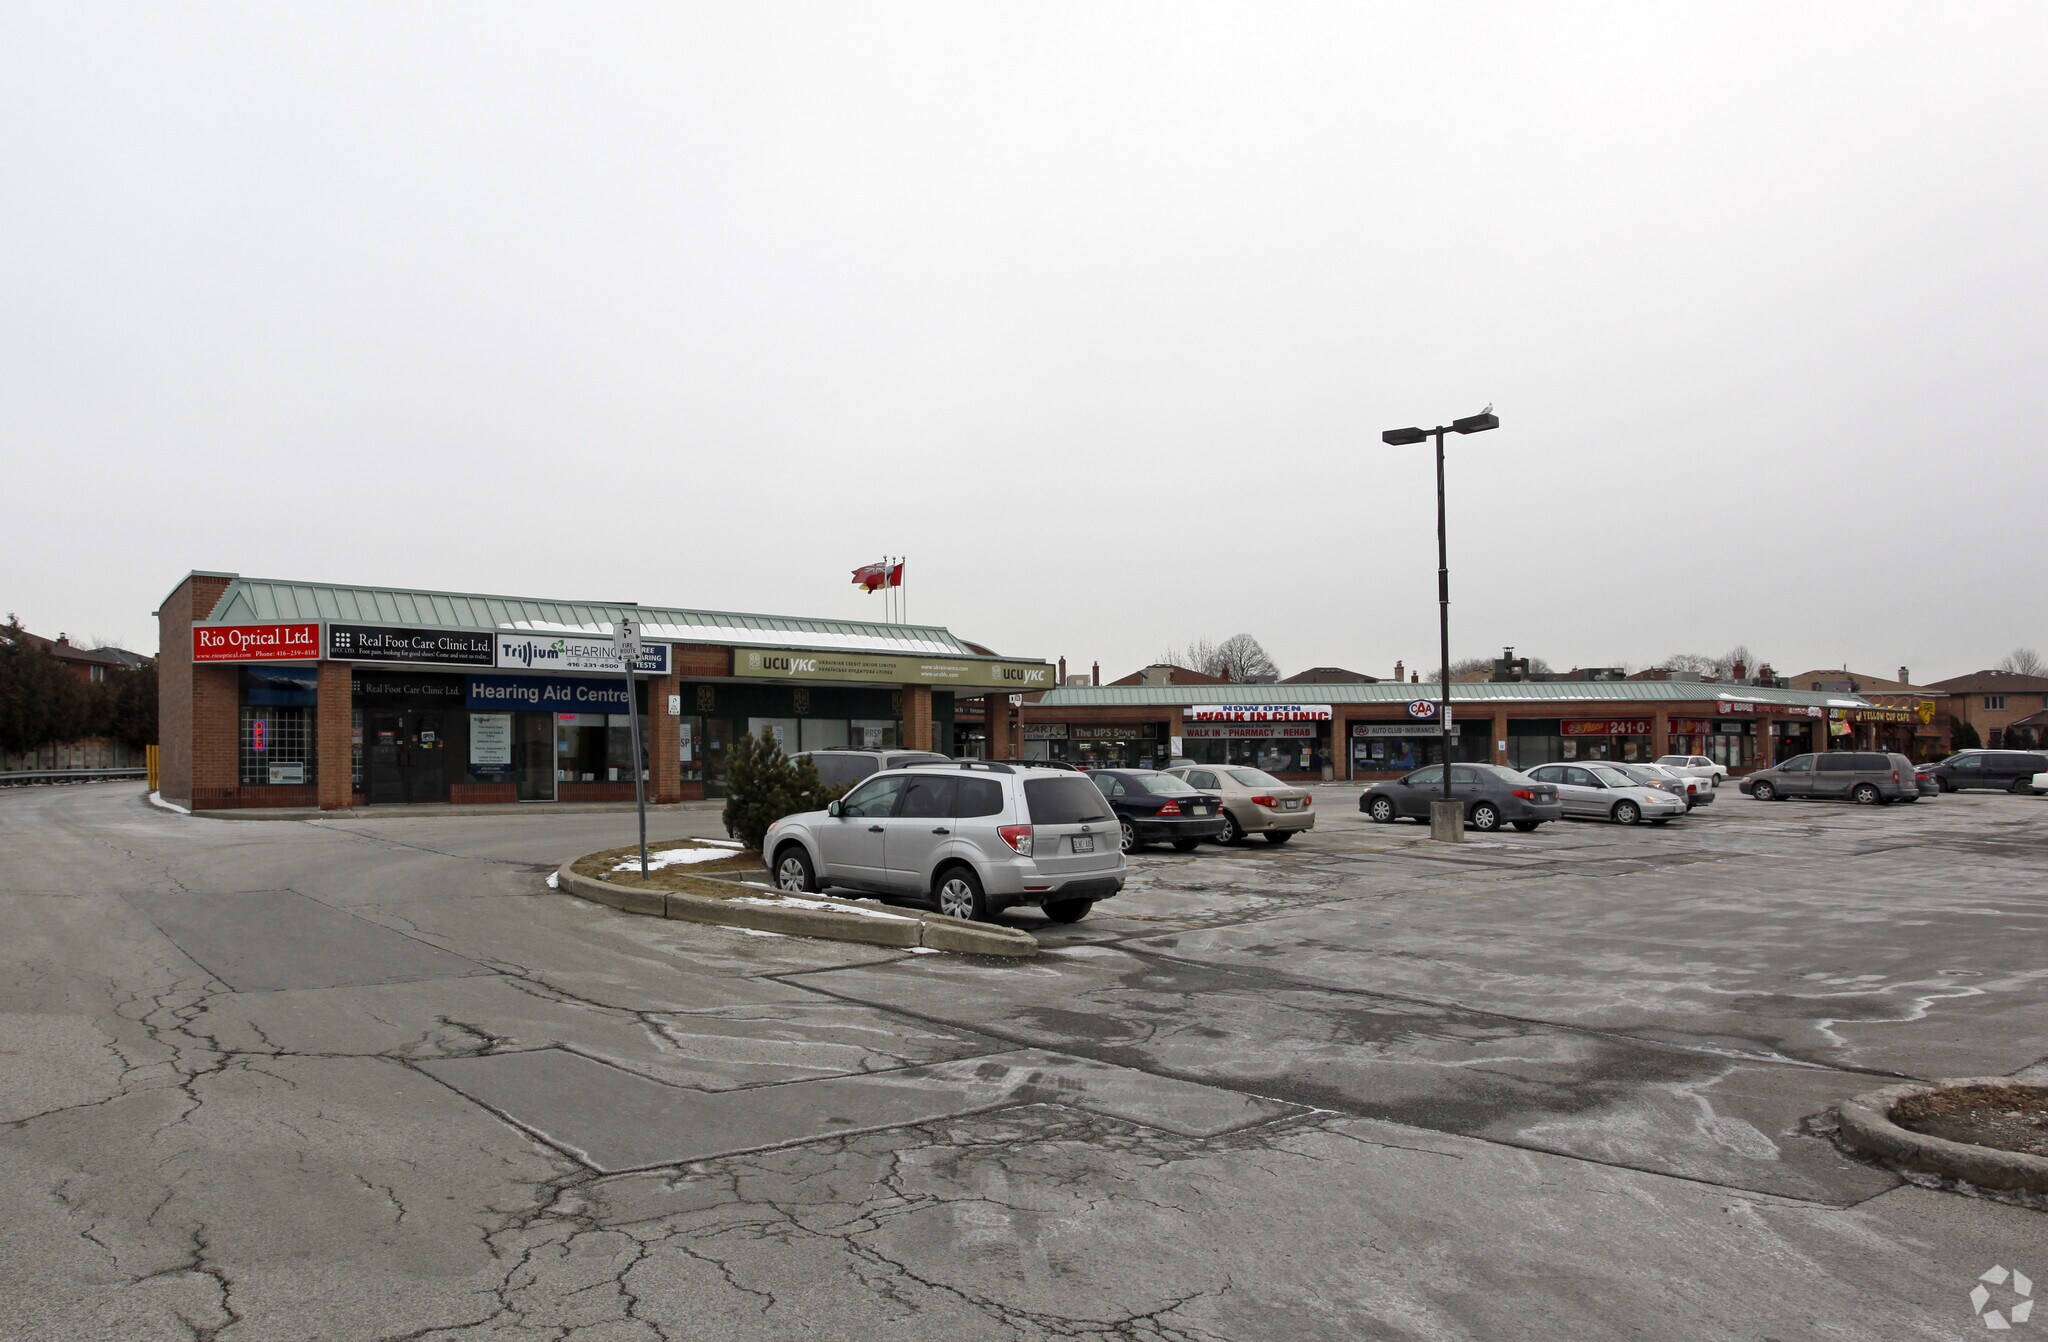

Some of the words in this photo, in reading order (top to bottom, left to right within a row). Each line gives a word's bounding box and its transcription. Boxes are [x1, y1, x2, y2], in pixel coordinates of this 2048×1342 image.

[200, 630, 225, 646] Rio
[228, 628, 280, 651] Optical
[284, 627, 313, 644] Ltd.
[359, 634, 382, 646] Real
[385, 635, 408, 648] Foot
[412, 636, 435, 649] Care
[438, 638, 468, 650] Clinic
[471, 640, 490, 652] Ltd.
[366, 684, 382, 692] Real
[384, 684, 402, 693] Foot
[404, 685, 420, 694] Care
[422, 686, 444, 695] Clinic
[472, 683, 539, 702] Hearing
[544, 686, 572, 700] Aid
[576, 686, 629, 702] Centre
[1410, 702, 1432, 716] CAA
[1196, 712, 1244, 722] WALK
[1250, 712, 1268, 722] IN
[1272, 712, 1330, 721] CLINIC
[1862, 710, 1884, 720] YELLOW
[865, 729, 882, 738] RRSP
[1025, 724, 1056, 733] ZART
[1076, 728, 1091, 736] The
[1094, 728, 1112, 736] UPS
[1114, 728, 1136, 736] Store
[680, 738, 690, 748] SP
